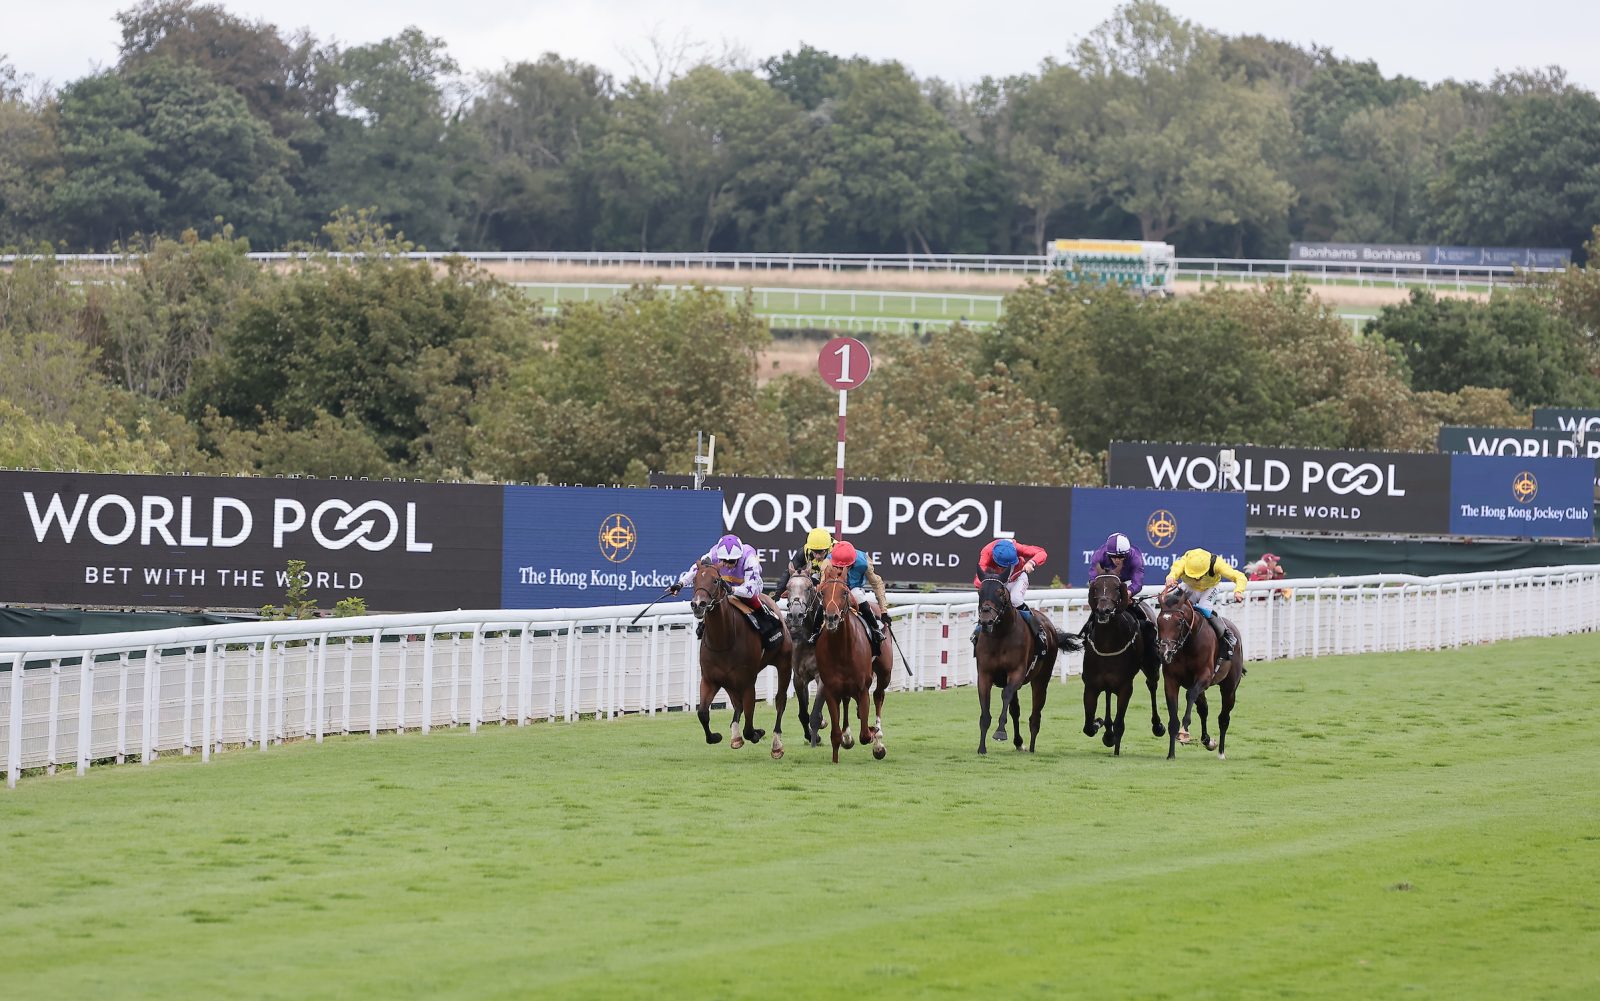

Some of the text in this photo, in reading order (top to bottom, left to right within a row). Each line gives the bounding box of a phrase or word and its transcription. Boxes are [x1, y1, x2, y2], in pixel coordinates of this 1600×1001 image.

[1300, 246, 1421, 261] Bonhams Bonhams
[834, 344, 854, 383] 1
[1145, 455, 1406, 497] WORLD POOL
[23, 491, 433, 552] WORLD POOL
[888, 496, 1016, 540] POOL
[1267, 504, 1297, 517] THE
[1304, 506, 1361, 520] WORLD
[1460, 504, 1588, 522] The Hong Kong Jockey Club
[757, 549, 780, 563] ET
[898, 553, 960, 567] WORLD
[85, 566, 132, 585] BET
[144, 567, 205, 586] WITH
[217, 569, 264, 587] THE
[518, 566, 546, 585] The
[549, 568, 587, 590] Hong
[590, 569, 627, 591] Kong
[628, 569, 677, 590] Jockey
